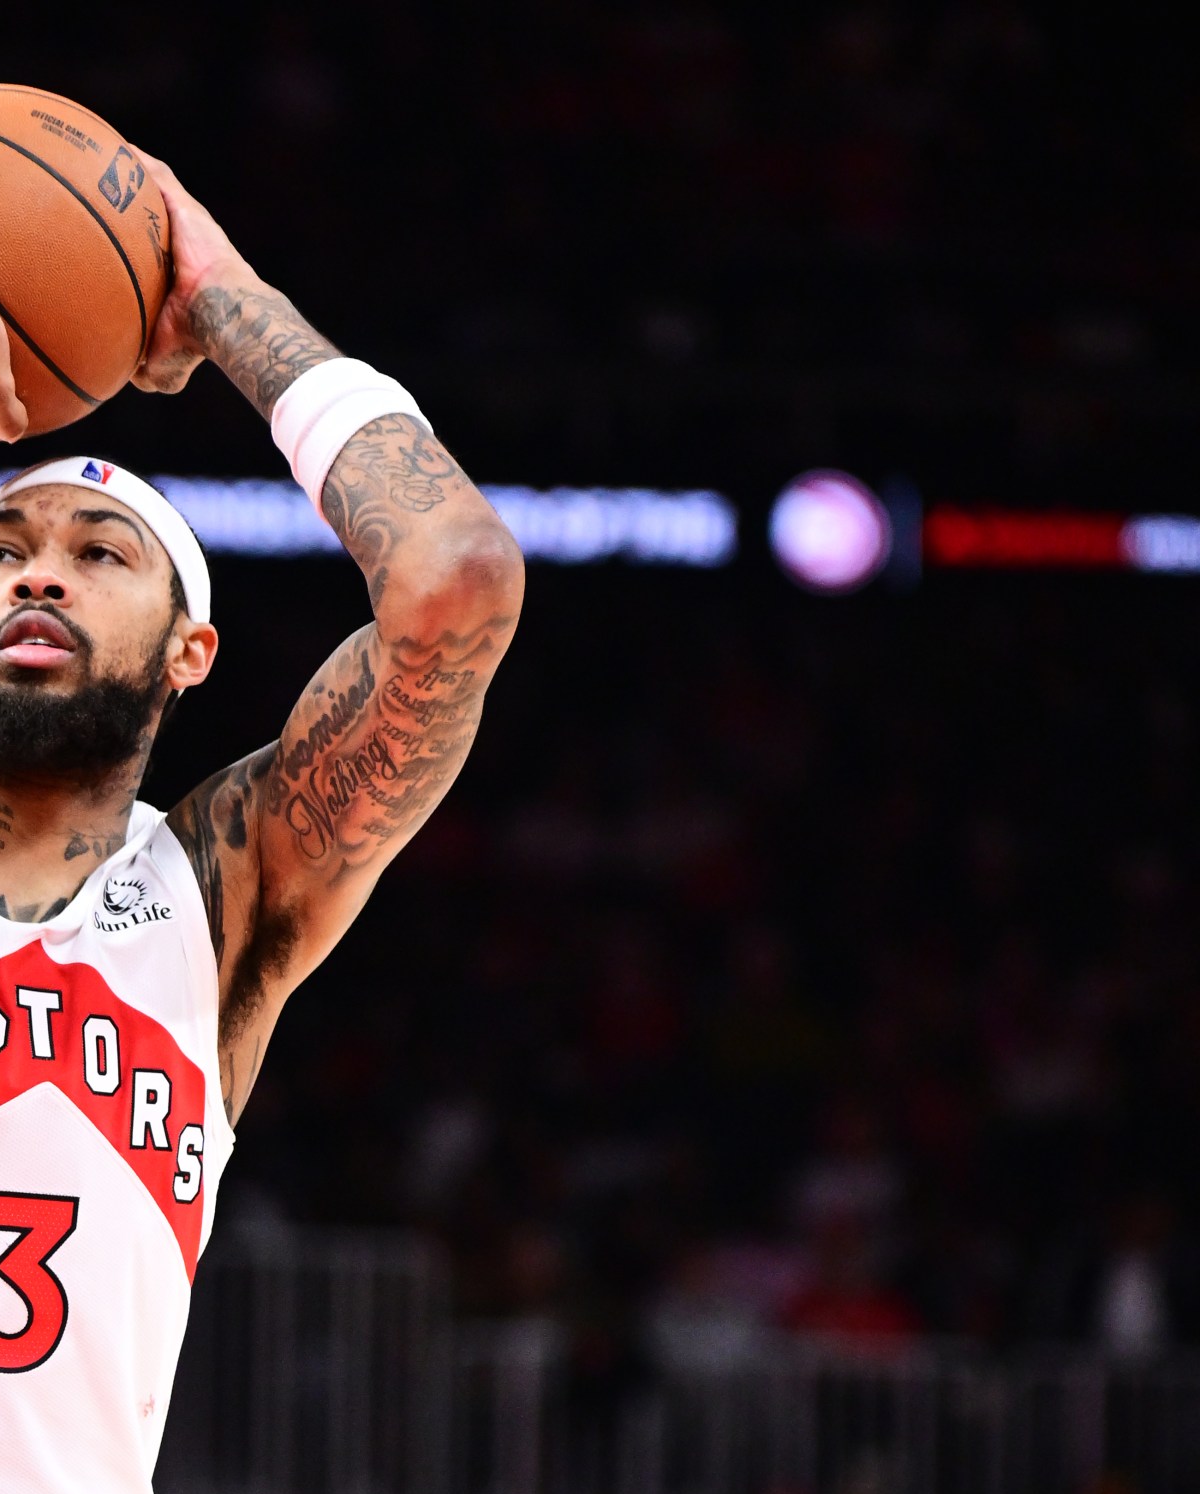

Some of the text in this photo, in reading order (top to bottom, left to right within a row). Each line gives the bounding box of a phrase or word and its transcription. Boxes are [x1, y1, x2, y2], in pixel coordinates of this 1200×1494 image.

[30, 109, 65, 129] OFFICIAL
[285, 730, 398, 859] Nothing
[93, 902, 173, 932] Sun Life
